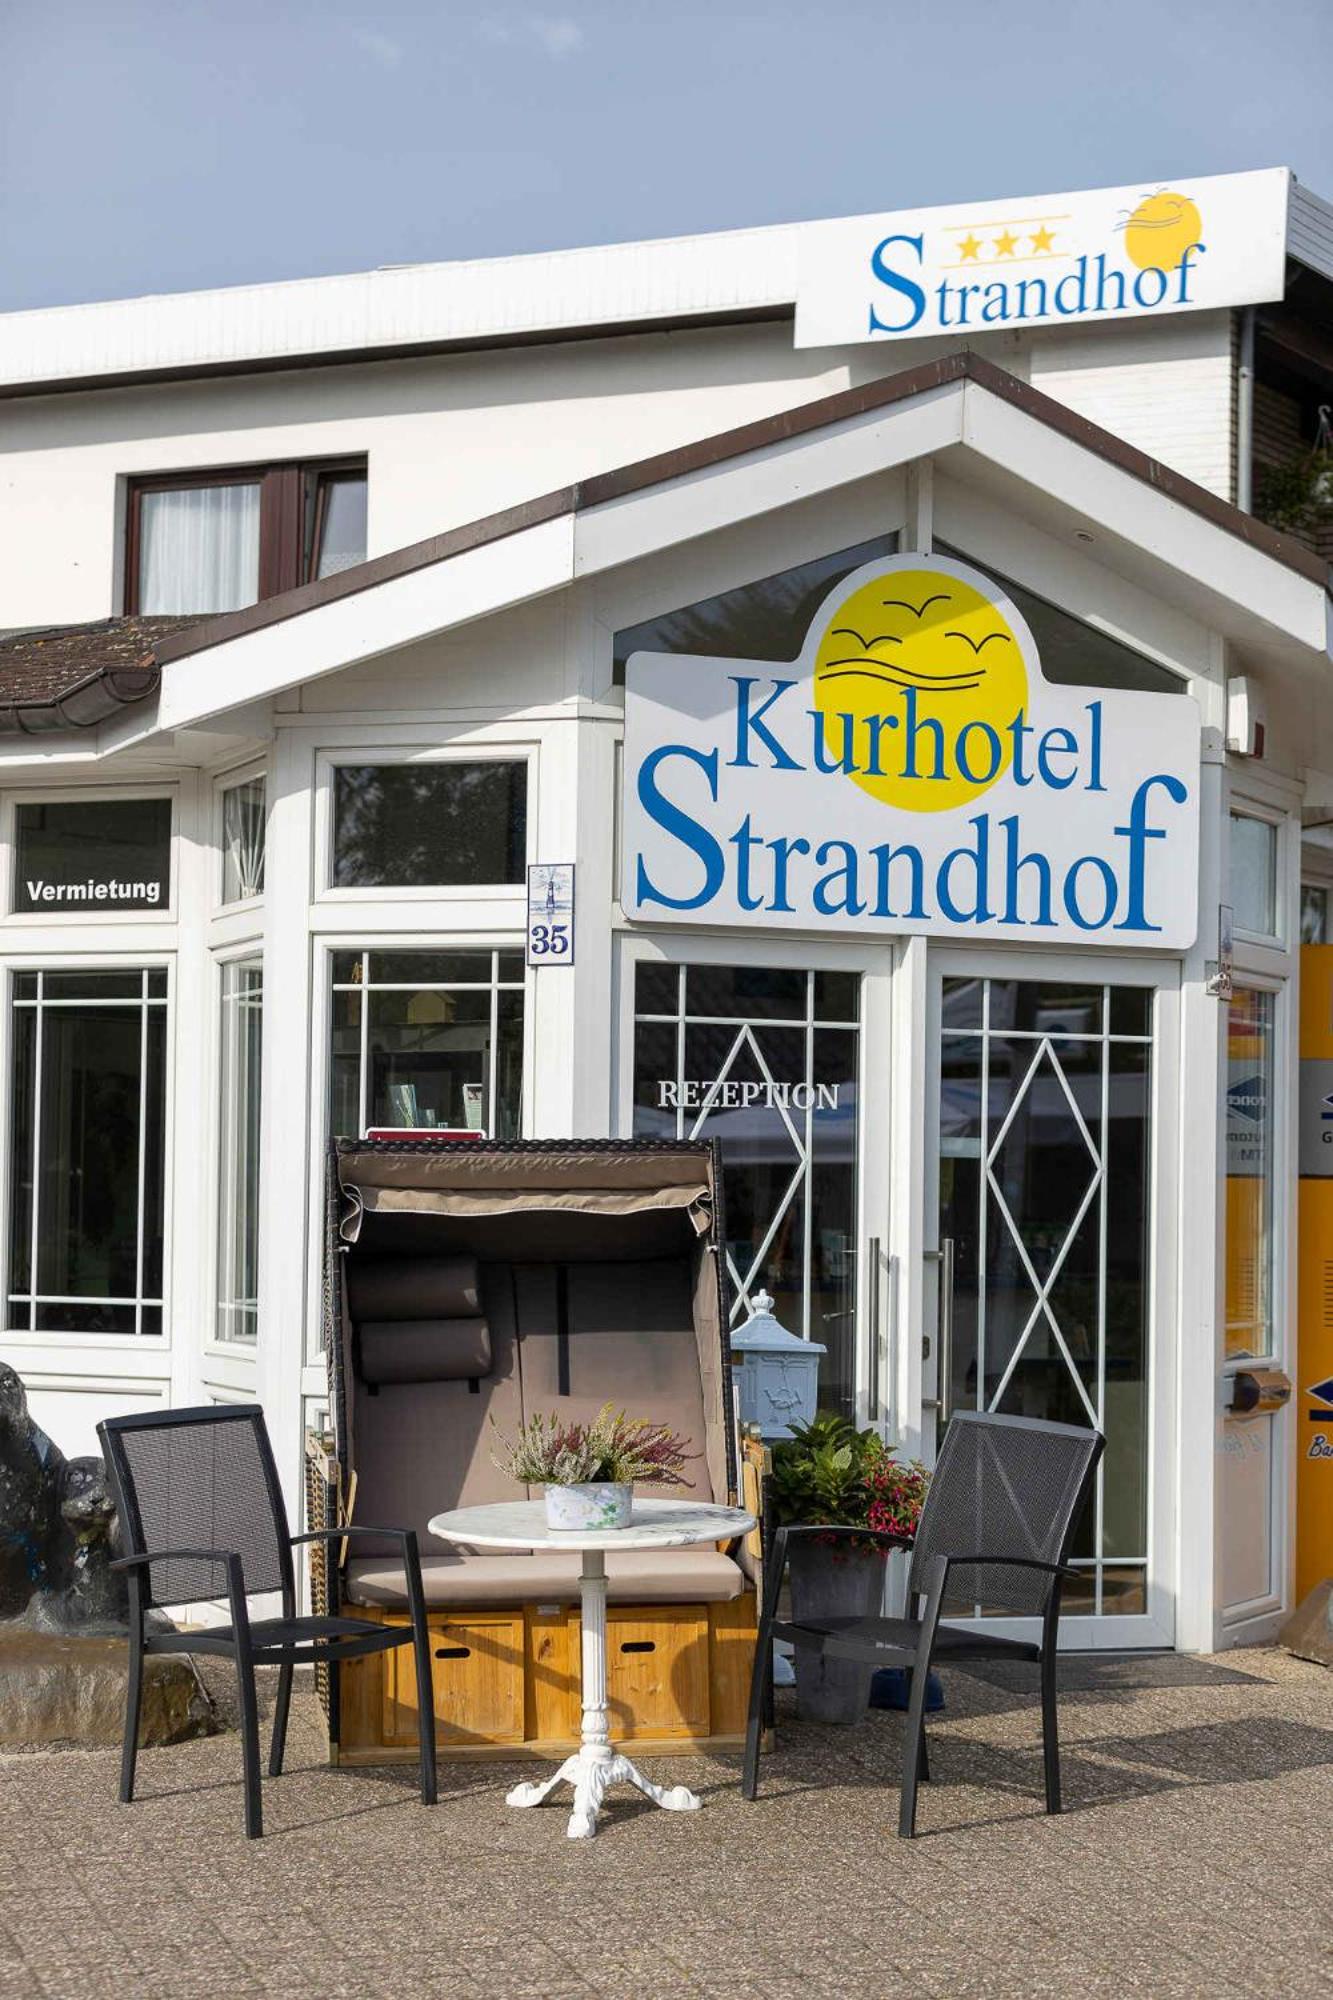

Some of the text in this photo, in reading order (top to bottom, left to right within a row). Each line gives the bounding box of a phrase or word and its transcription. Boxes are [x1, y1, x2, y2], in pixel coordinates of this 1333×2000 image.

[867, 233, 1207, 334] Strandhof
[726, 676, 1108, 792] Kurhotel
[635, 743, 1189, 932] Strandhof
[26, 879, 161, 903] Vermietung
[531, 925, 569, 955] 35
[657, 1080, 841, 1110] REZEPTION
